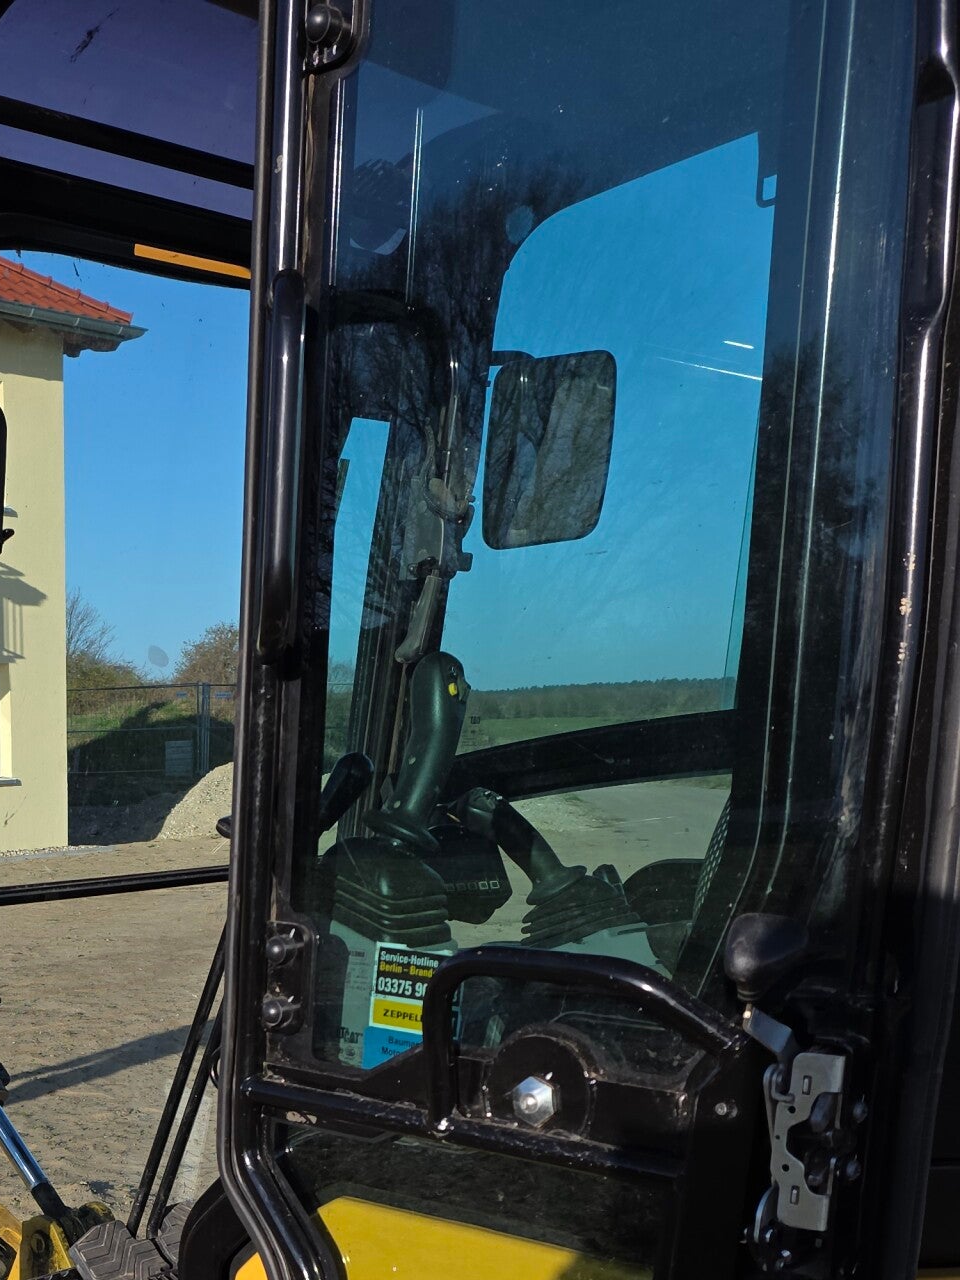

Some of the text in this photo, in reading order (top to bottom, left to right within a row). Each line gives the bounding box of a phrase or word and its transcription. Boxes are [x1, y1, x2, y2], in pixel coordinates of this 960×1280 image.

[380, 950, 439, 968] Service-Hotline
[380, 961, 403, 973] Berlin
[409, 965, 436, 978] Brand
[377, 976, 412, 996] 03375
[388, 1036, 419, 1049] Bauma
